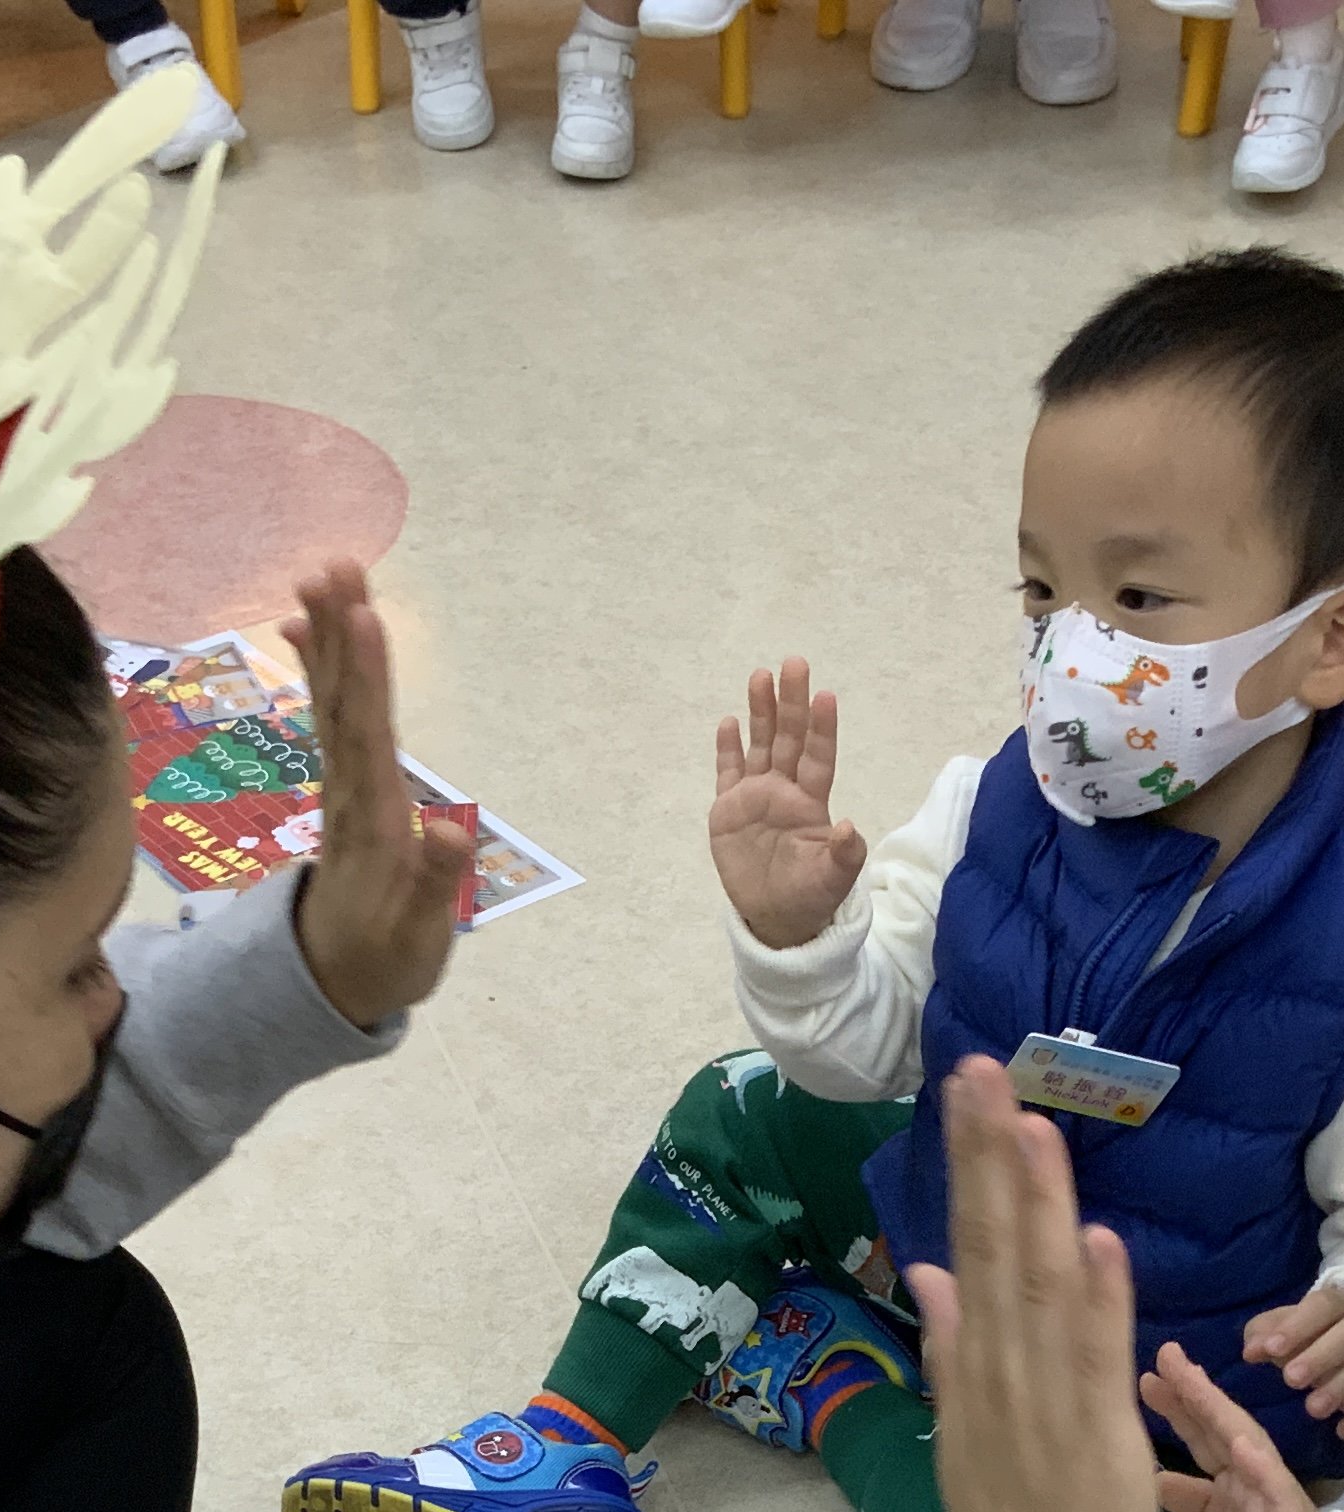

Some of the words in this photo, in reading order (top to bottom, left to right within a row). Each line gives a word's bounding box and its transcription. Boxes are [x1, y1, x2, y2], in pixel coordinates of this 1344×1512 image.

[162, 811, 219, 850] YEAR
[663, 1138, 677, 1160] TO
[679, 1161, 702, 1183] OUR
[702, 1183, 737, 1221] PLANET
